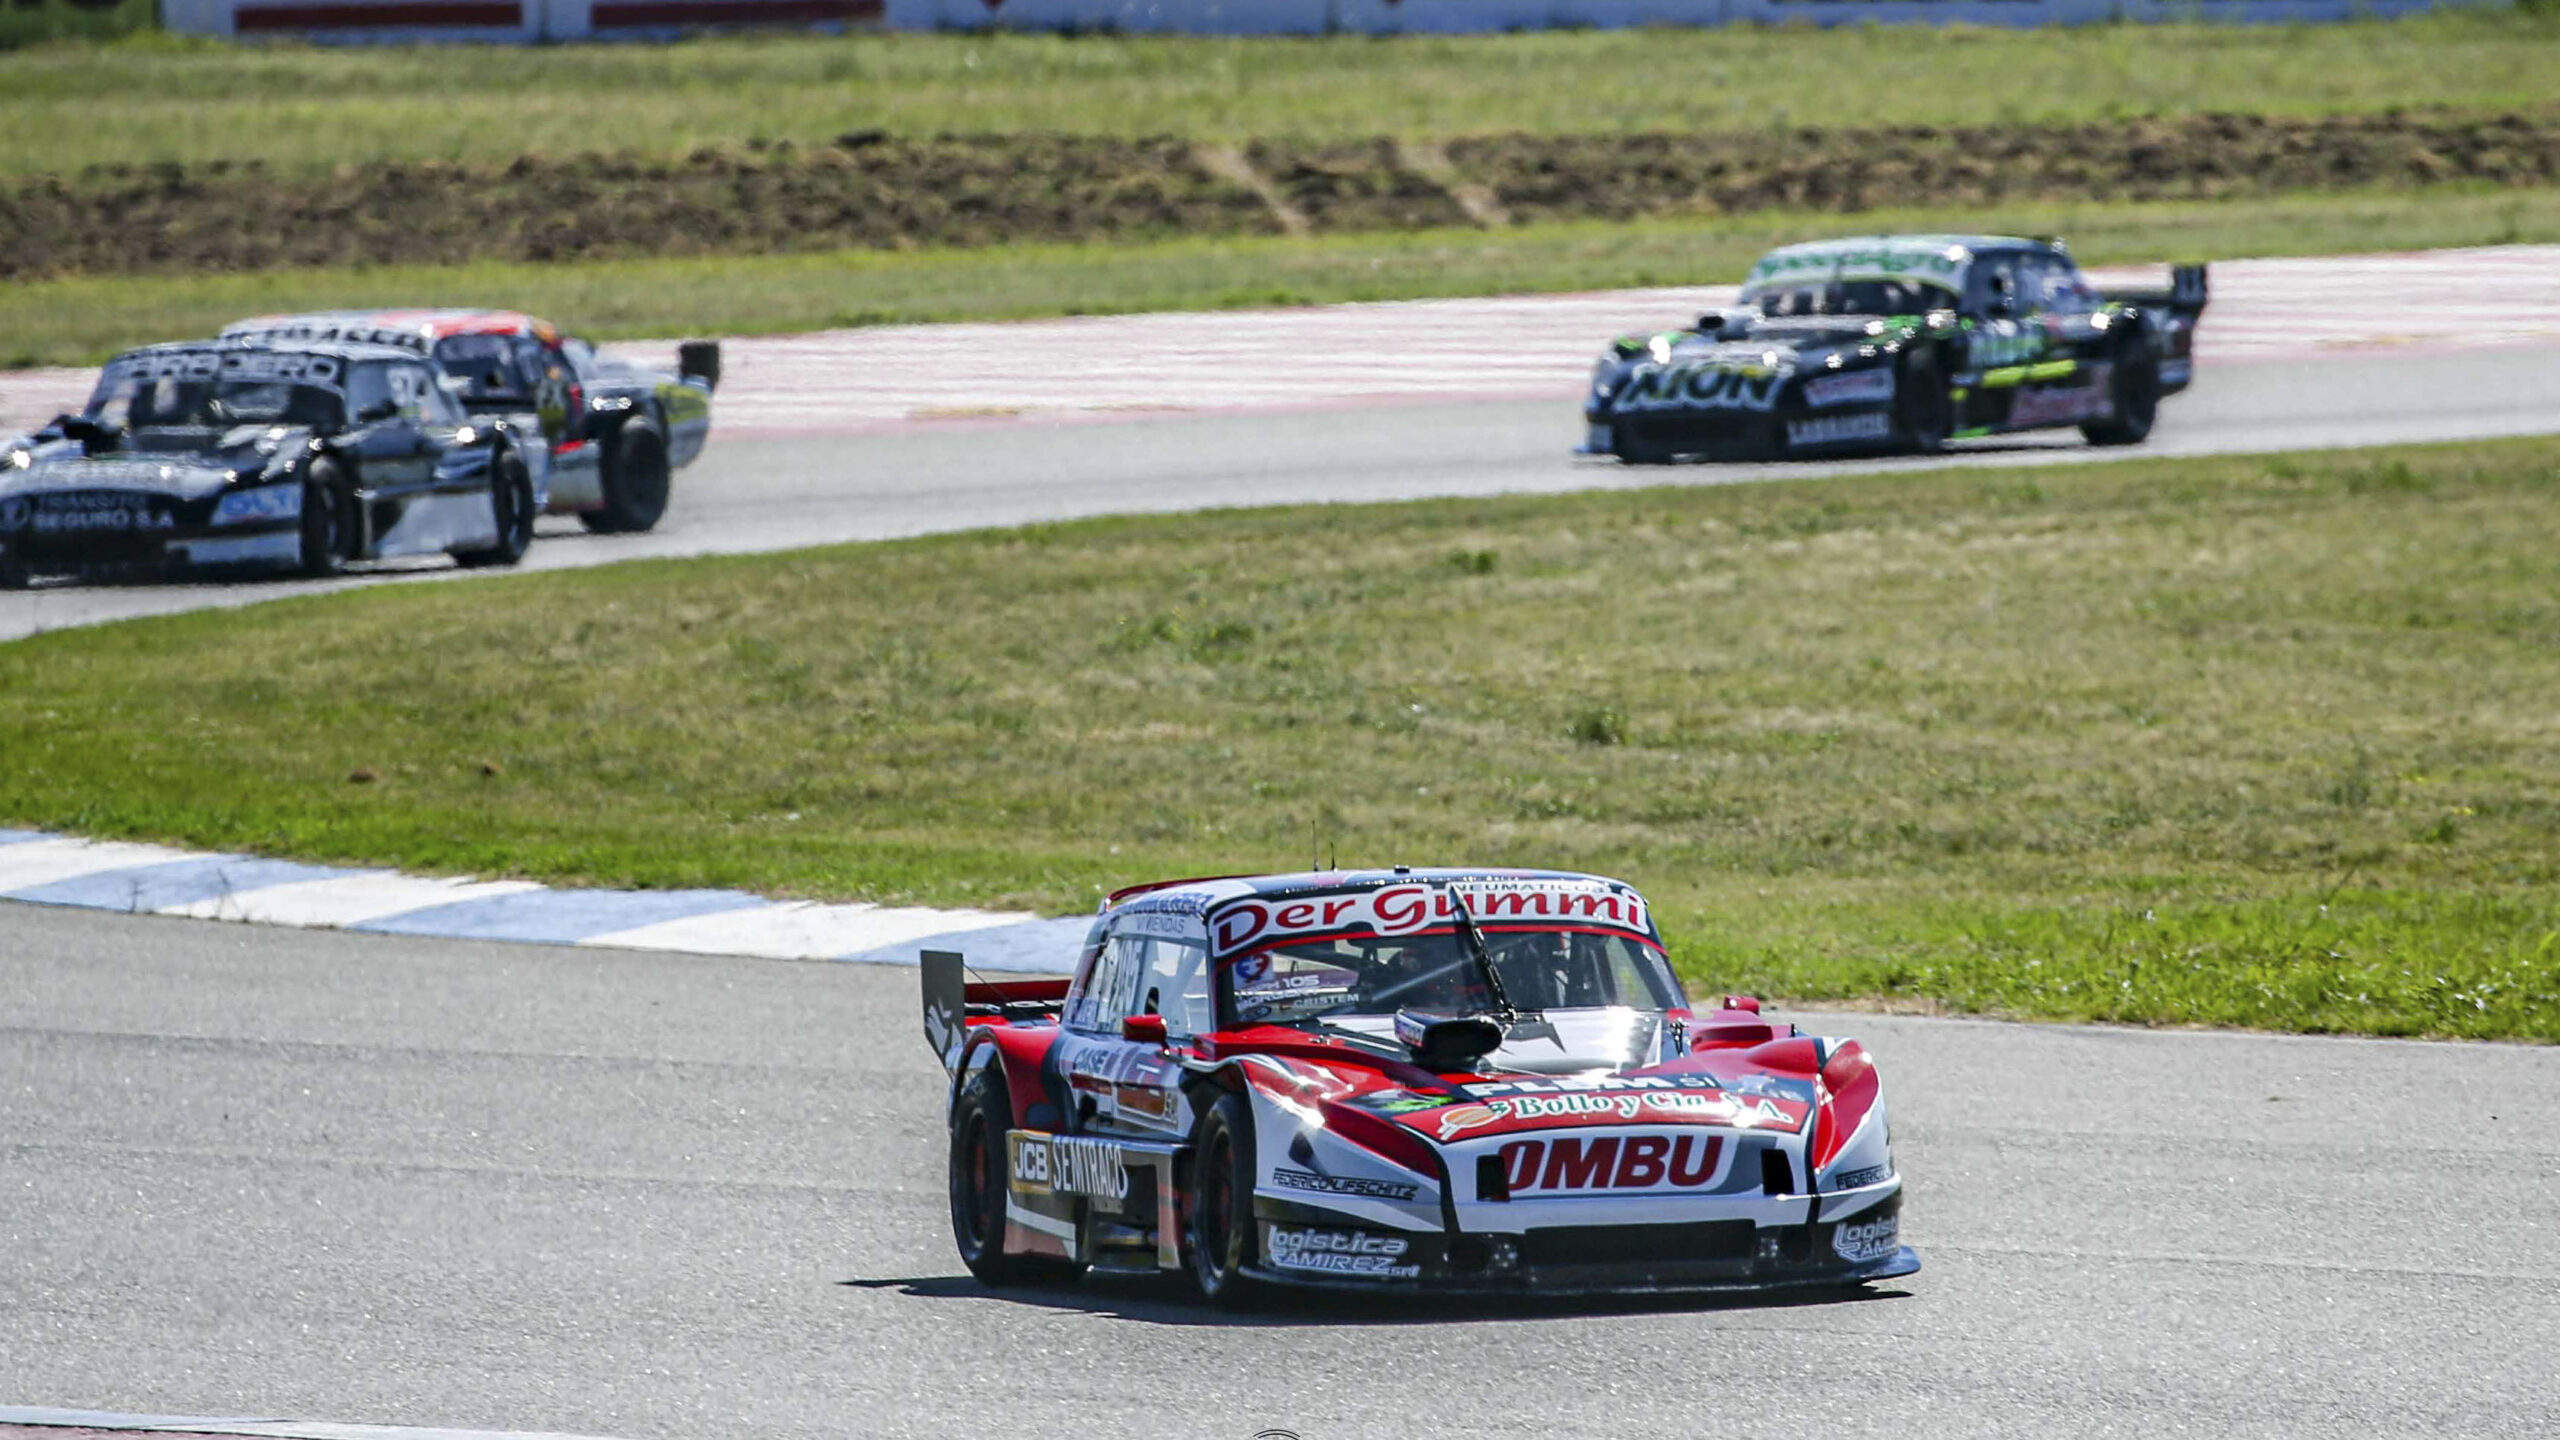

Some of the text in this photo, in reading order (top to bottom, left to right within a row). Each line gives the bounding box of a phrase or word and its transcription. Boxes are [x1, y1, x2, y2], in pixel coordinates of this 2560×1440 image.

[1213, 887, 1641, 951] Der Gummi
[1511, 1095, 1612, 1119] Bollo
[1014, 1142, 1049, 1181] JCB
[1273, 1172, 1328, 1188] FEDERICO
[1498, 1135, 1724, 1191] OMBU
